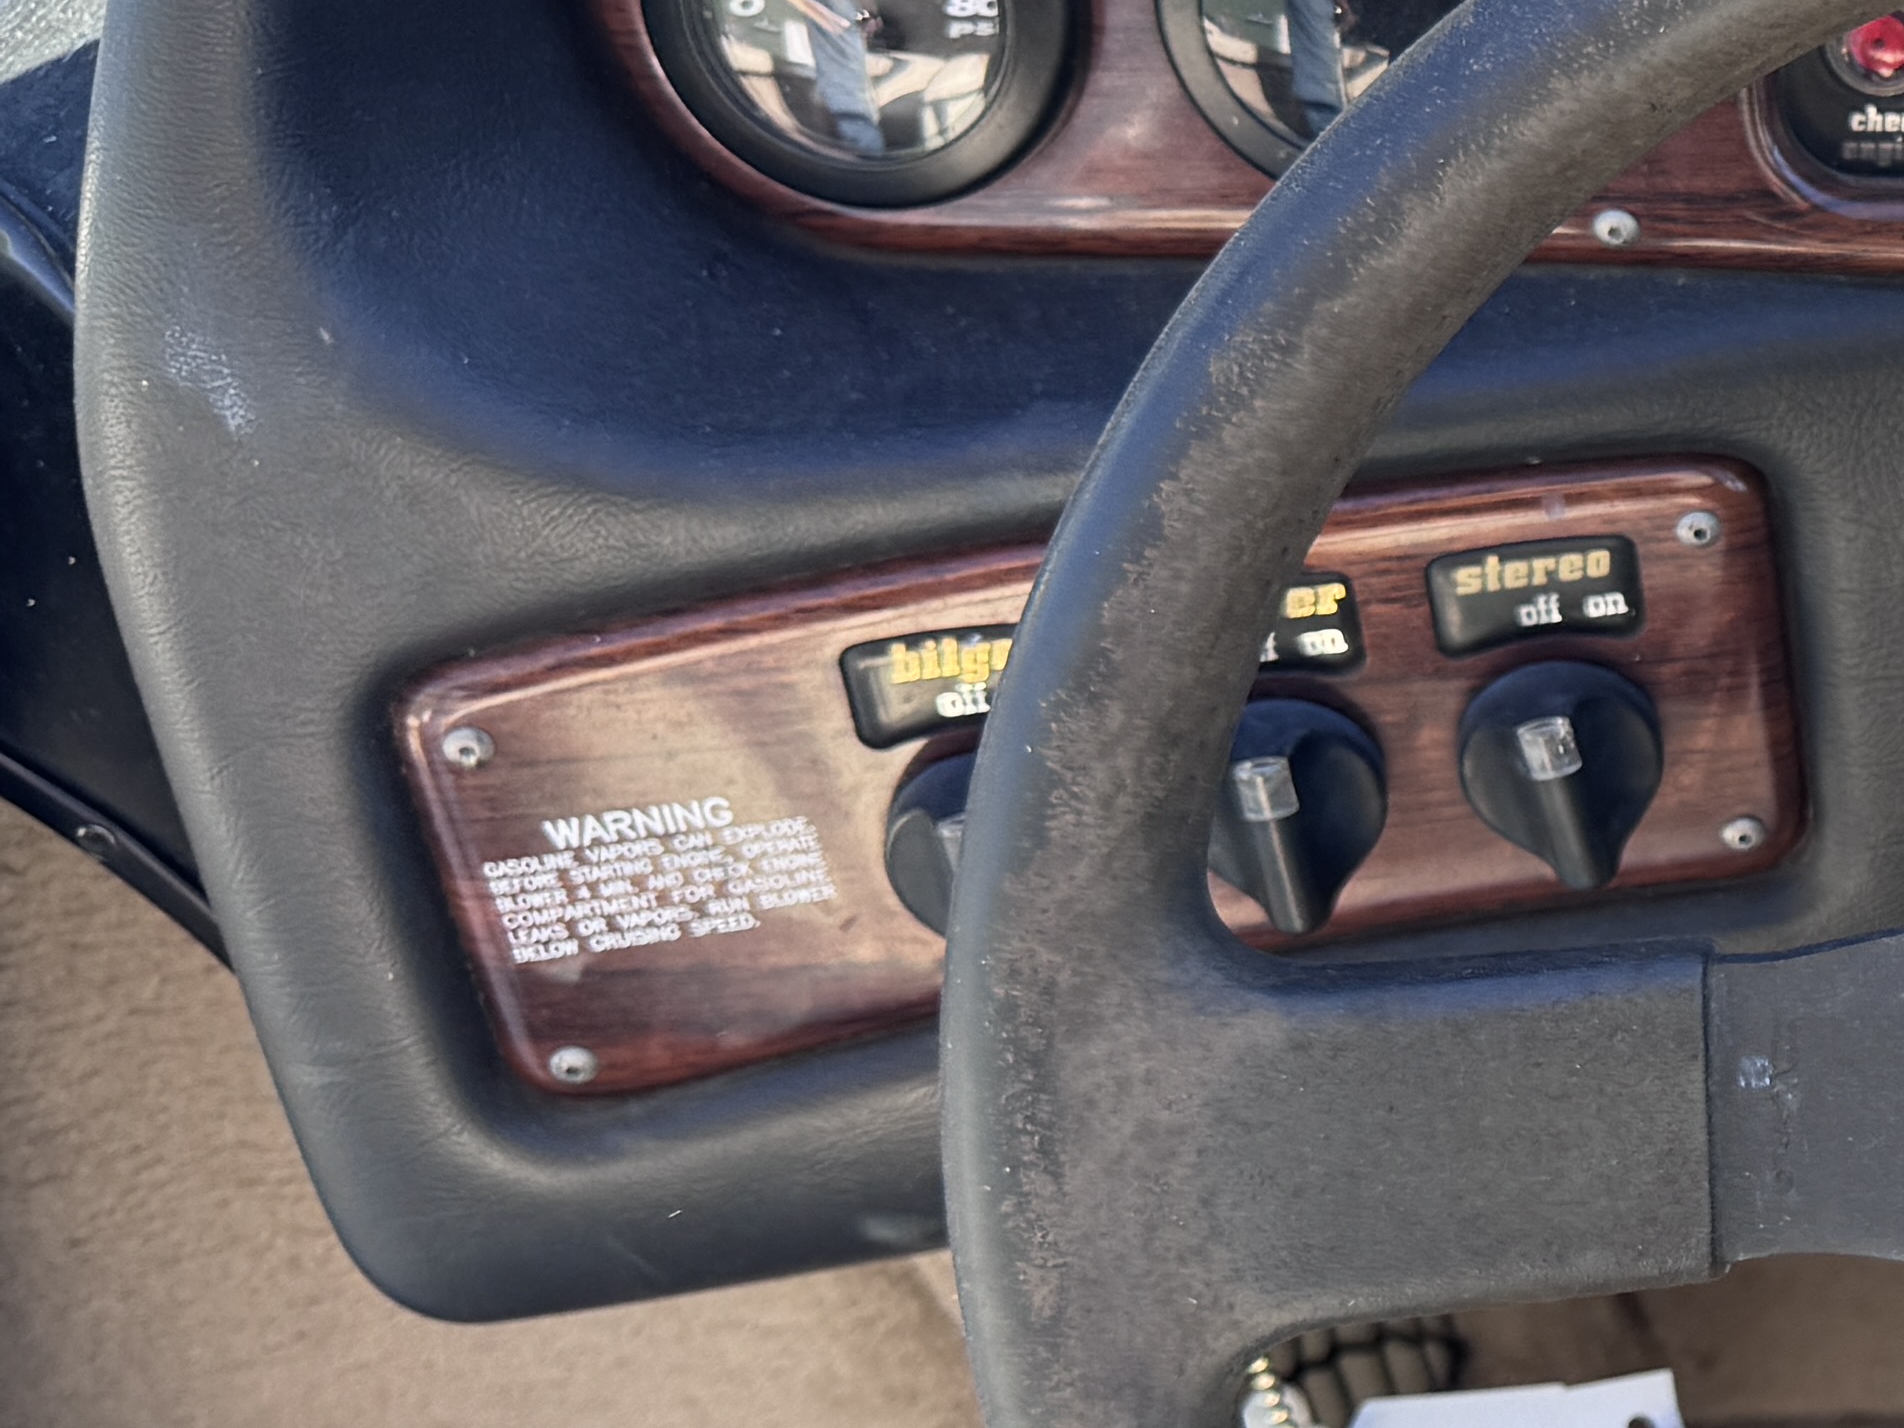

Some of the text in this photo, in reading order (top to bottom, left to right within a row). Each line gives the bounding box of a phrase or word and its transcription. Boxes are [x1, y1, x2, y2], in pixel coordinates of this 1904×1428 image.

[1454, 549, 1612, 596] stereo
[1514, 592, 1629, 626] off on
[1297, 629, 1348, 655] on
[542, 796, 733, 850] WARNING
[483, 851, 578, 878] GASOLINE
[673, 833, 712, 851] CAN
[502, 892, 660, 930] COMPARTMENT
[671, 884, 715, 904] FOR
[577, 917, 607, 937] OR
